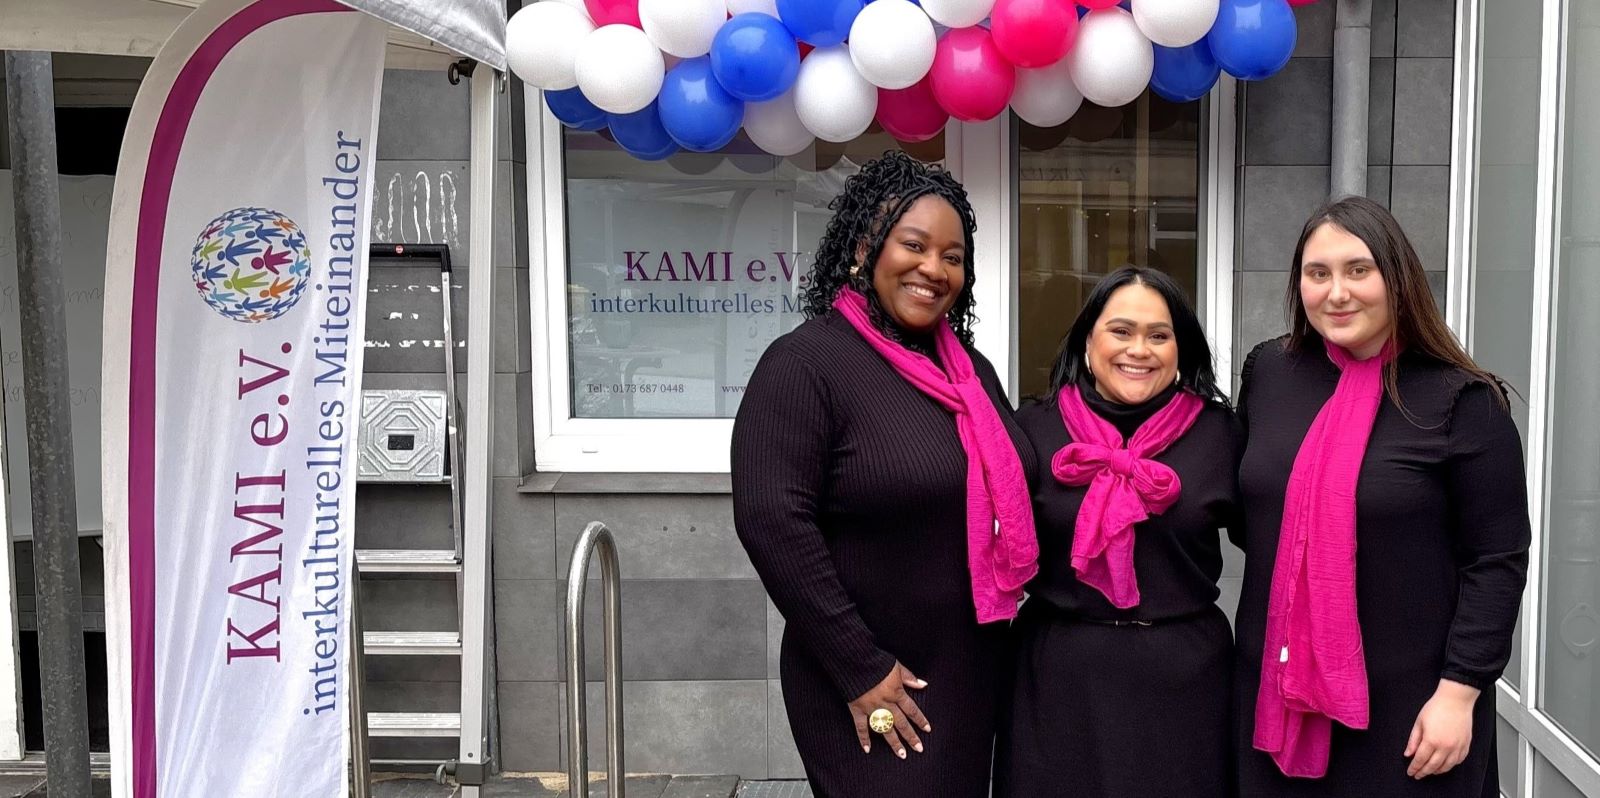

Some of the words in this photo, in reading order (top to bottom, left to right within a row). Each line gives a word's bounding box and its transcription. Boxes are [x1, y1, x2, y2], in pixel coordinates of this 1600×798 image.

[313, 130, 363, 388] Miteinander
[623, 251, 734, 282] KAMI
[746, 251, 807, 283] e.V.
[591, 293, 774, 314] interkulturelles
[237, 341, 291, 447] e.V.
[612, 383, 637, 394] 0173
[639, 383, 657, 394] 687
[660, 383, 685, 394] 0448
[722, 385, 746, 394] www
[226, 469, 287, 665] KAMI
[302, 399, 346, 716] interkulturelles
